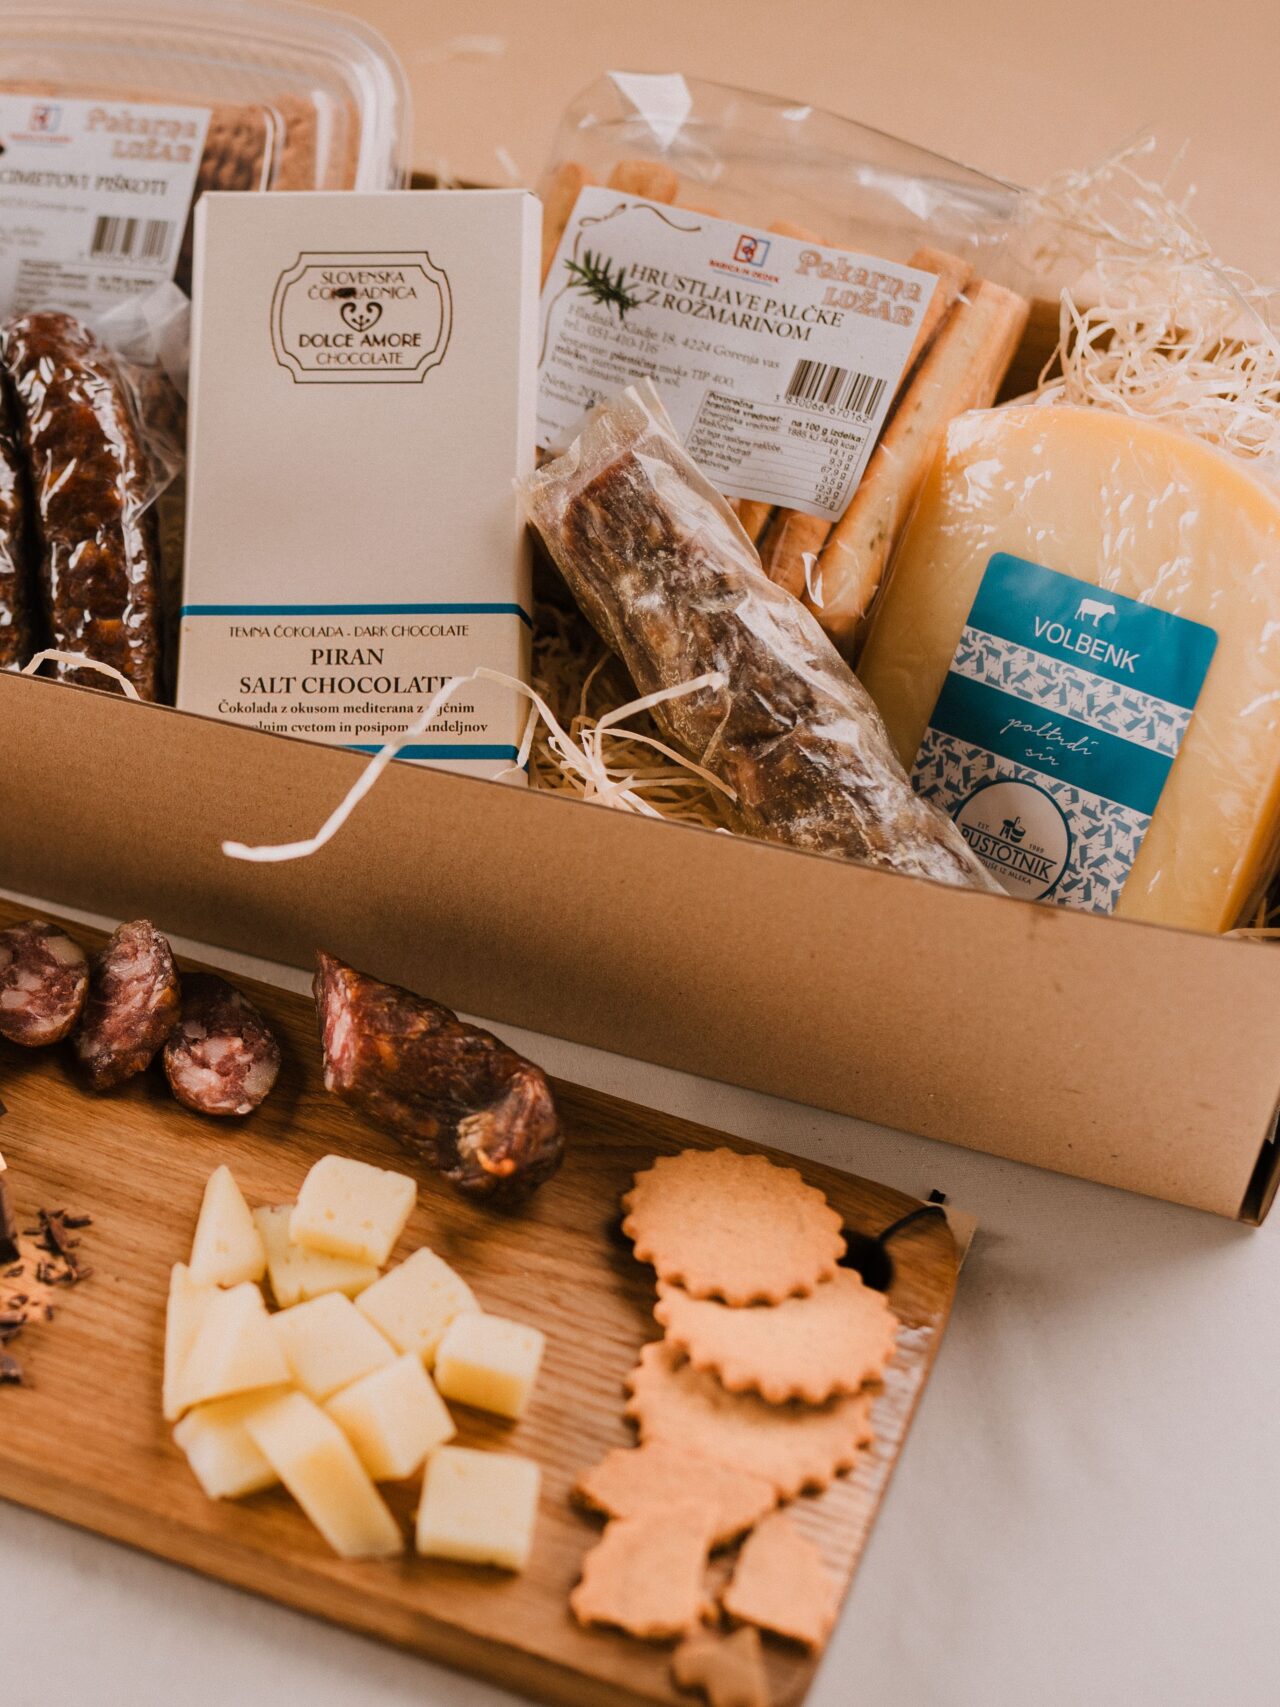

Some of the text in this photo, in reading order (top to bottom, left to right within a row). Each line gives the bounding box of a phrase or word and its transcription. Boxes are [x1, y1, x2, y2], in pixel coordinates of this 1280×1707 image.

[321, 271, 405, 285] SLOVENSKA
[629, 263, 845, 328] HRUSTLJAVE PALČKE
[645, 290, 812, 342] Z ROŽMARINOM
[298, 333, 421, 348] DOLCE AMORE
[791, 419, 801, 427] na
[805, 422, 820, 432] 100
[229, 626, 270, 638] TEMNA
[274, 623, 343, 638] ČOKOLADA
[354, 625, 388, 638] DARK
[391, 624, 470, 637] CHOCOLATE
[1034, 616, 1140, 673] VOLBENK
[310, 648, 384, 666] PIRAN
[239, 676, 296, 694] SALT
[218, 699, 278, 713] Čokolada
[280, 705, 288, 713] z
[290, 702, 339, 713] okusom
[342, 702, 414, 713] mediterana
[417, 704, 424, 713] z
[290, 722, 336, 732] cvetom
[339, 721, 352, 732] in
[425, 720, 488, 736] andeljnov
[961, 828, 1054, 879] PUSTOTNIK
